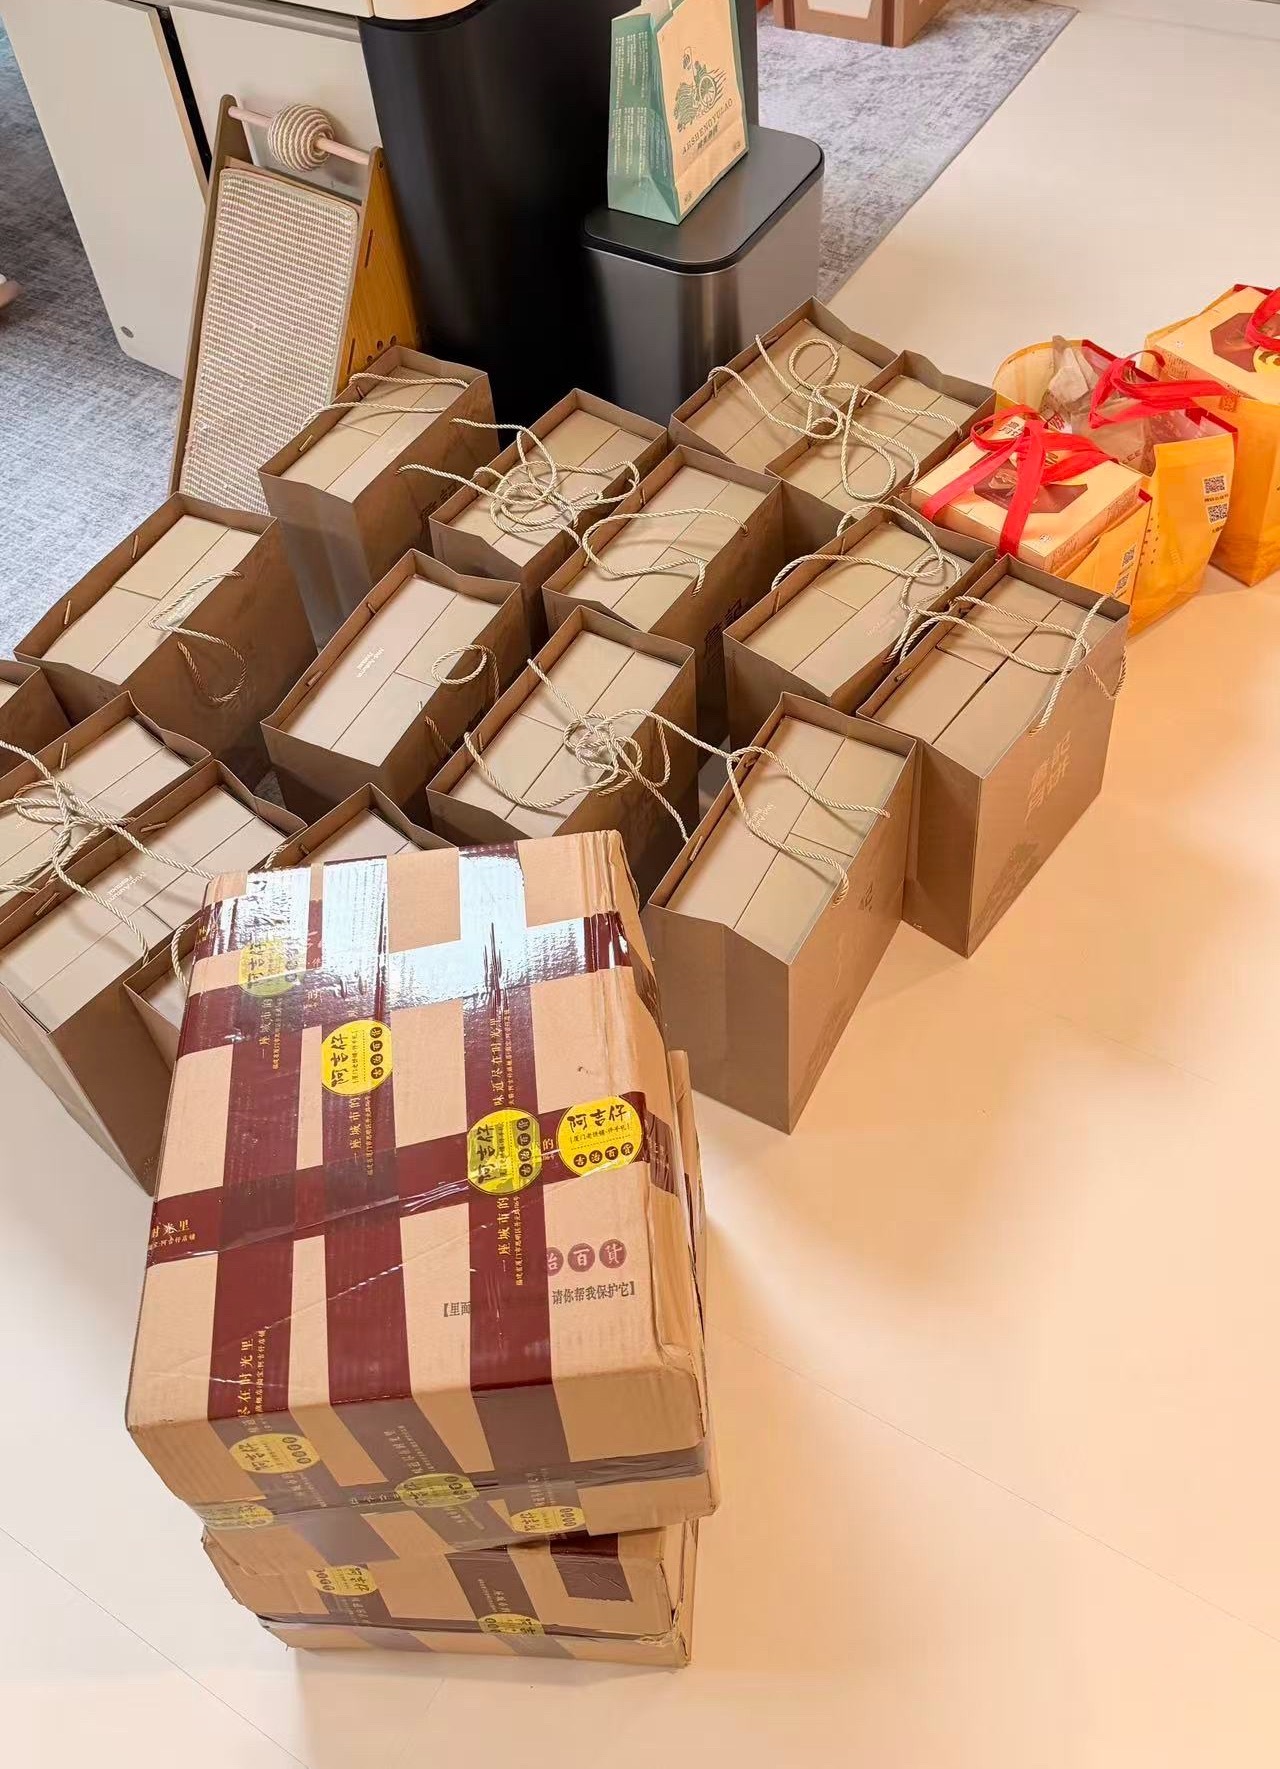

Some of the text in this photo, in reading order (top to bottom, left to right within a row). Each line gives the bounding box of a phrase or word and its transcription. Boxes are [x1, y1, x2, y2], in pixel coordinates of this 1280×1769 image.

[330, 1034, 349, 1087] 阿吉仔
[349, 1097, 362, 1165] 一座城市的
[566, 1103, 627, 1133] 阿吉仔
[476, 1124, 496, 1184] 阿吉仔
[496, 1197, 511, 1272] 一座城市的
